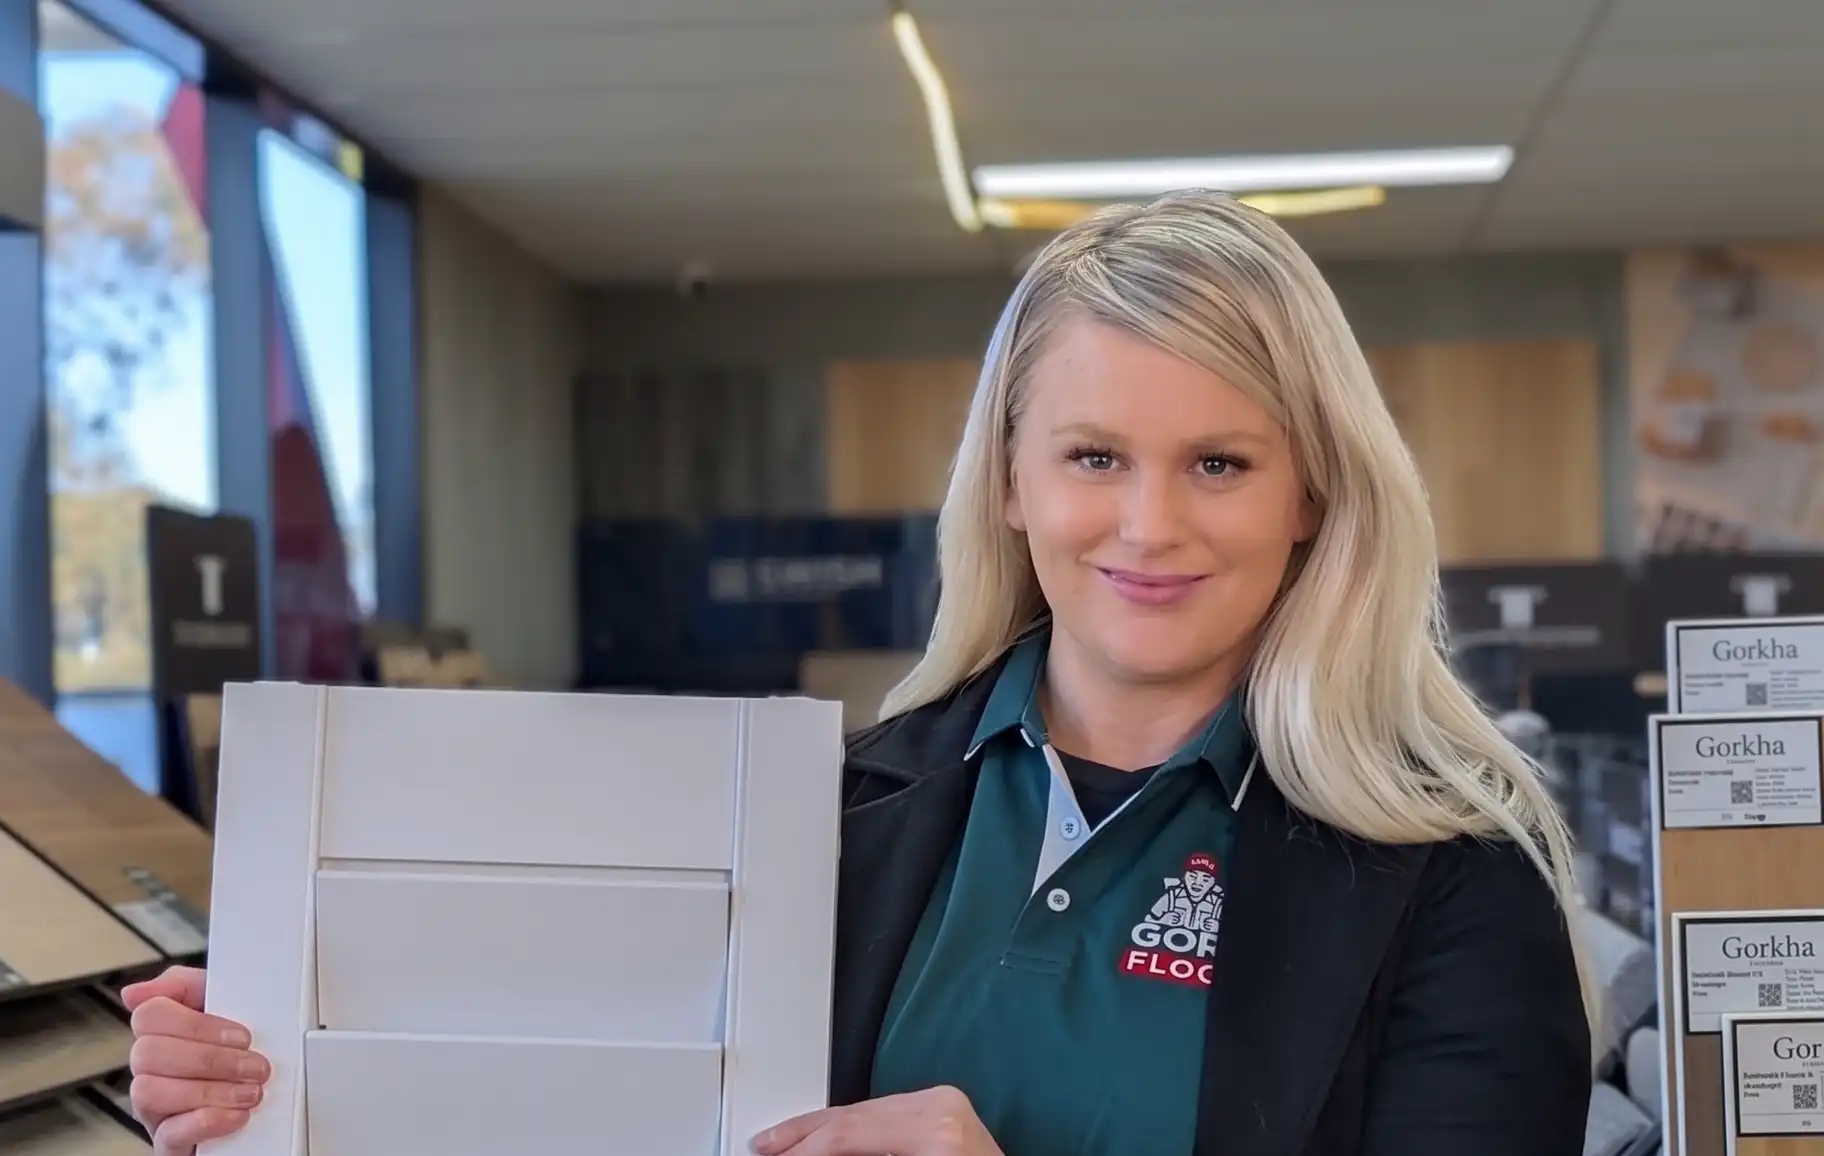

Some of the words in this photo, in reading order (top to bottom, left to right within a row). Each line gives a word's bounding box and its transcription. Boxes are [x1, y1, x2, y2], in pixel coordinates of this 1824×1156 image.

[1712, 638, 1799, 662] Gorkha
[1695, 734, 1786, 758] Gorkha
[1721, 934, 1815, 959] Gorkha
[1772, 1036, 1823, 1060] Gor
